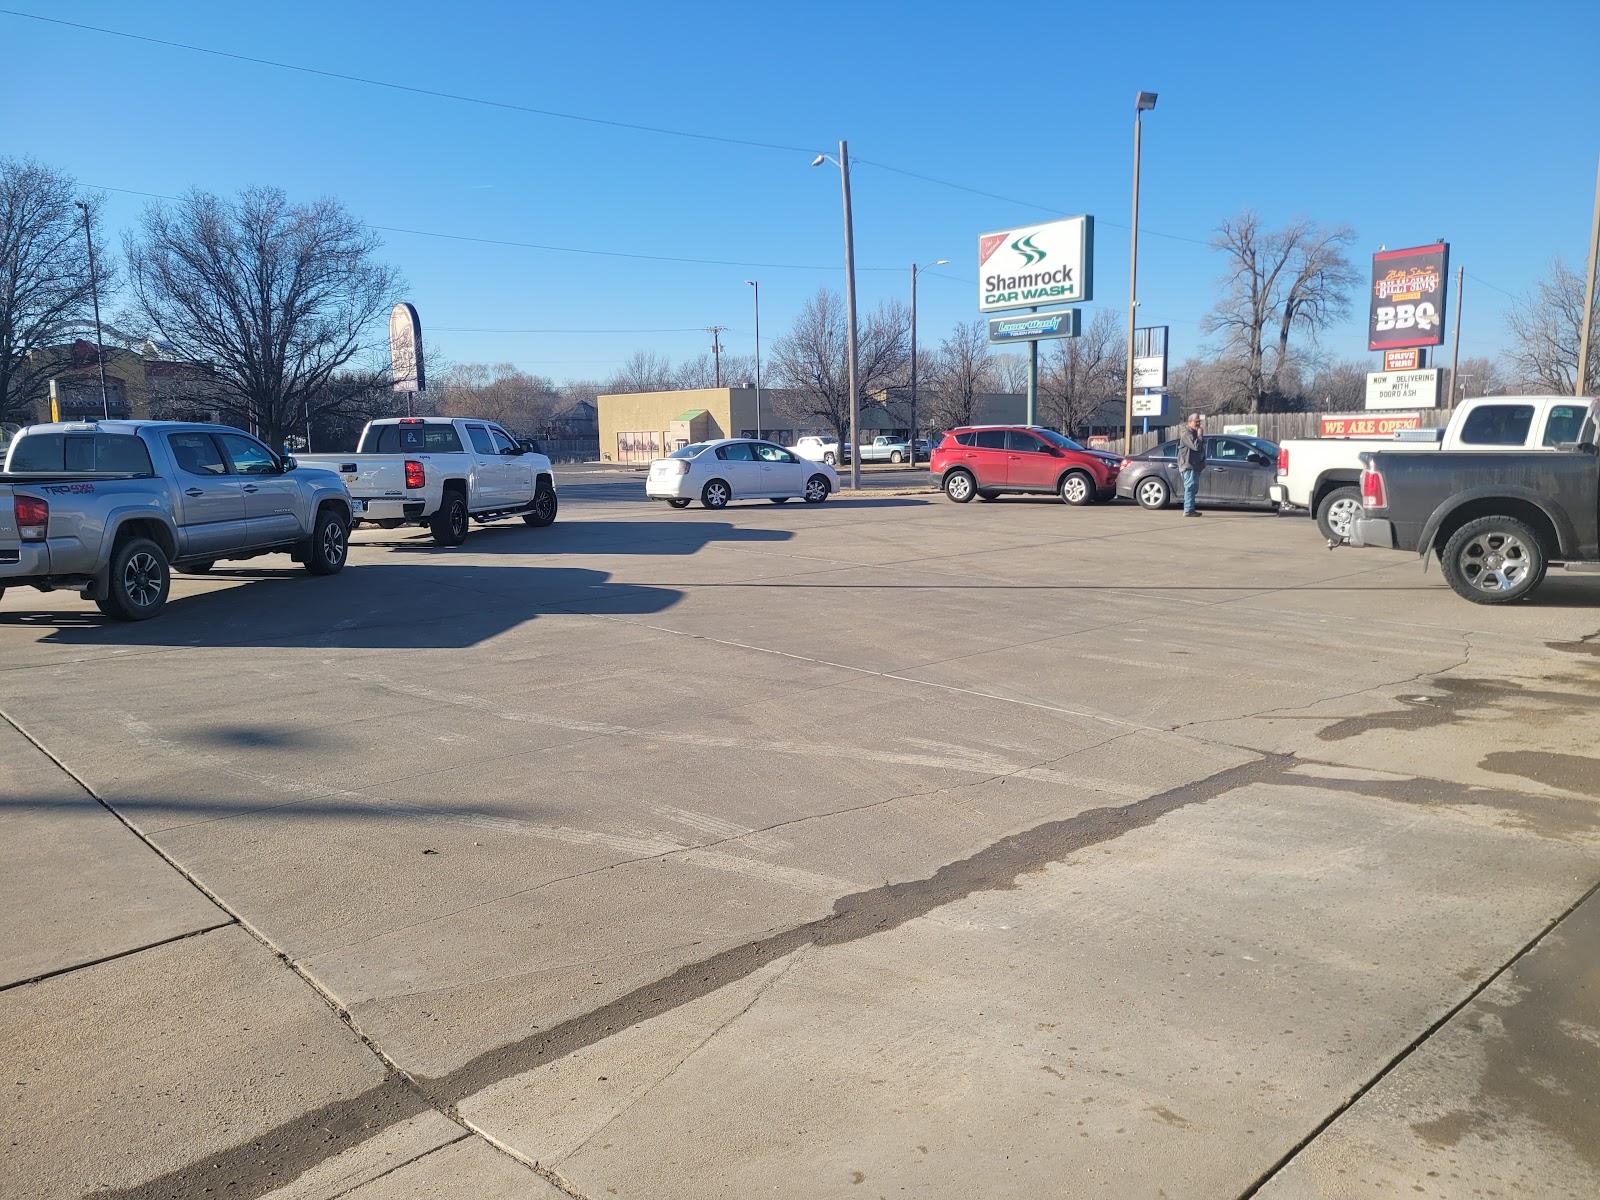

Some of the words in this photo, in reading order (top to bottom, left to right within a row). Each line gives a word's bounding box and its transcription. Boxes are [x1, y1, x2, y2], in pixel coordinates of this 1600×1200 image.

[985, 264, 1072, 293] Shamrock
[985, 291, 1018, 304] CAR
[1021, 284, 1074, 299] WASH
[1376, 302, 1437, 331] BBQ
[1388, 352, 1415, 361] DRIVE
[1390, 360, 1413, 368] THRU
[1373, 376, 1387, 384] NOW
[1396, 373, 1435, 383] DELIVERING
[1325, 421, 1344, 434] WE
[1348, 420, 1375, 433] ARE
[40, 485, 70, 495] TRD
